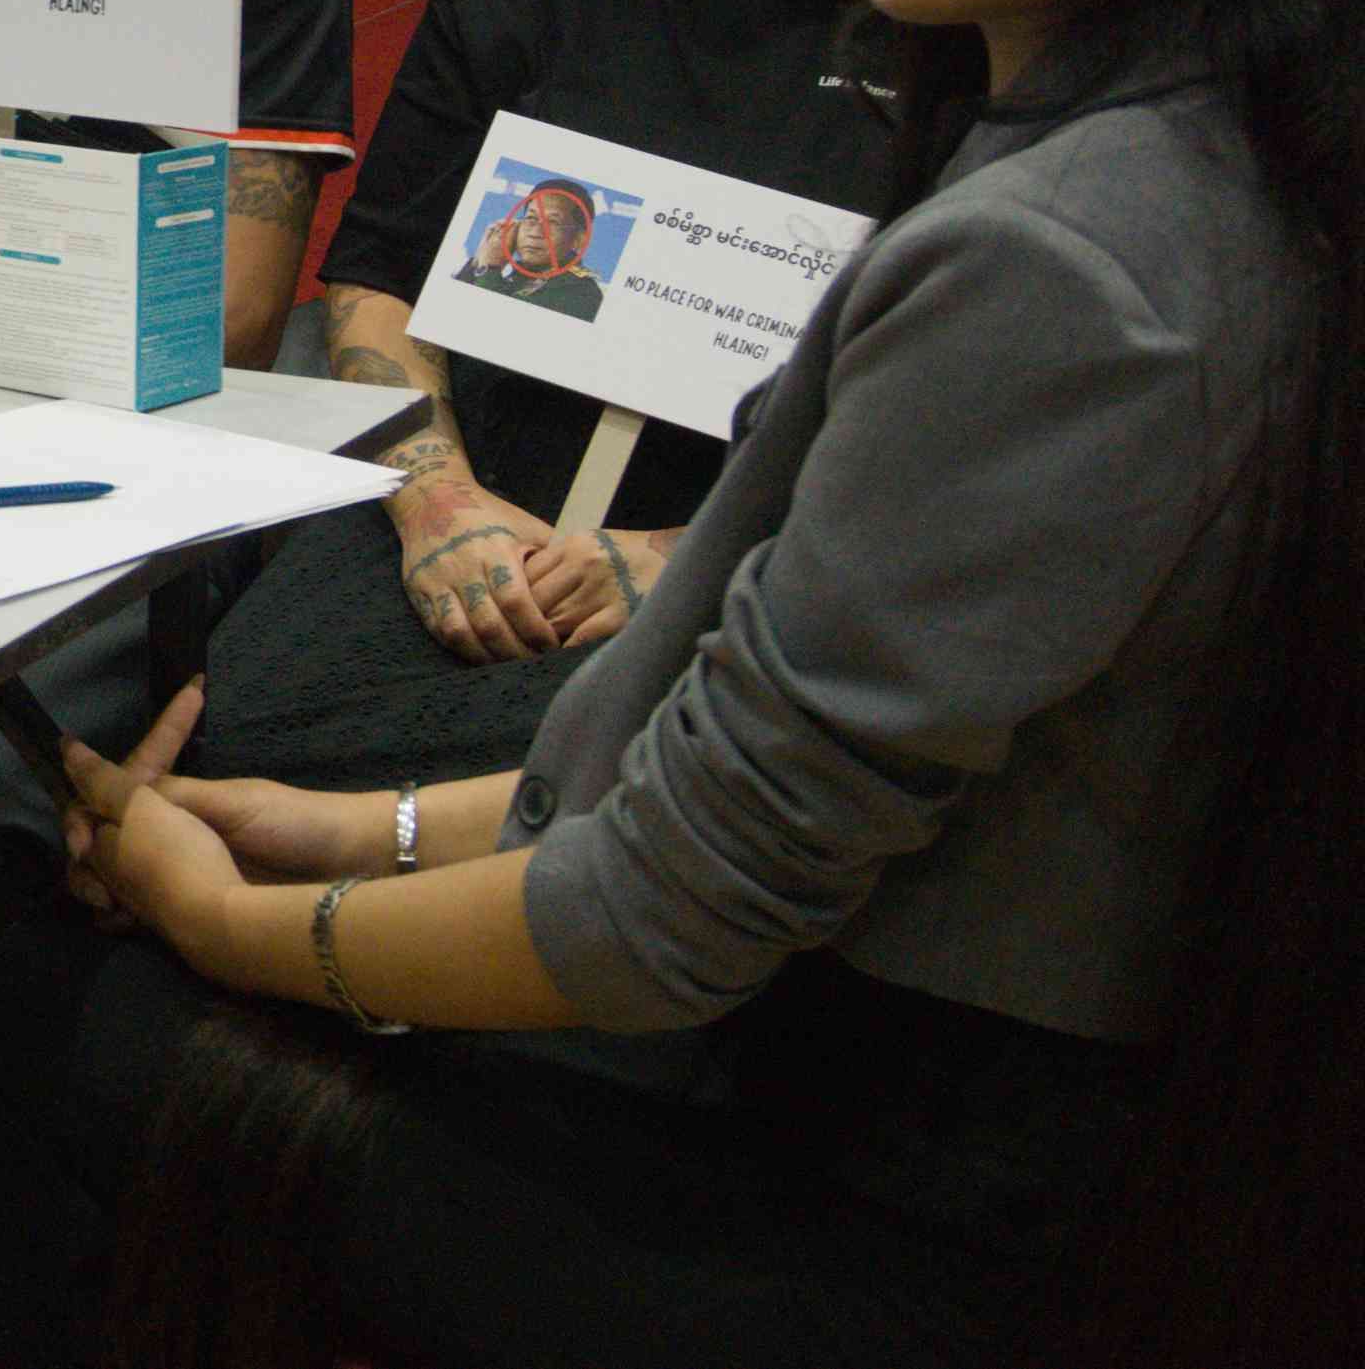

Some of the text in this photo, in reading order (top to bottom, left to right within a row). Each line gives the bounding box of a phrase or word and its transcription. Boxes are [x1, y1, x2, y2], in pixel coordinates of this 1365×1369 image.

[624, 275, 806, 341] NO PLACE FOR WAR CRIMINA
[712, 330, 770, 361] HLAING!
